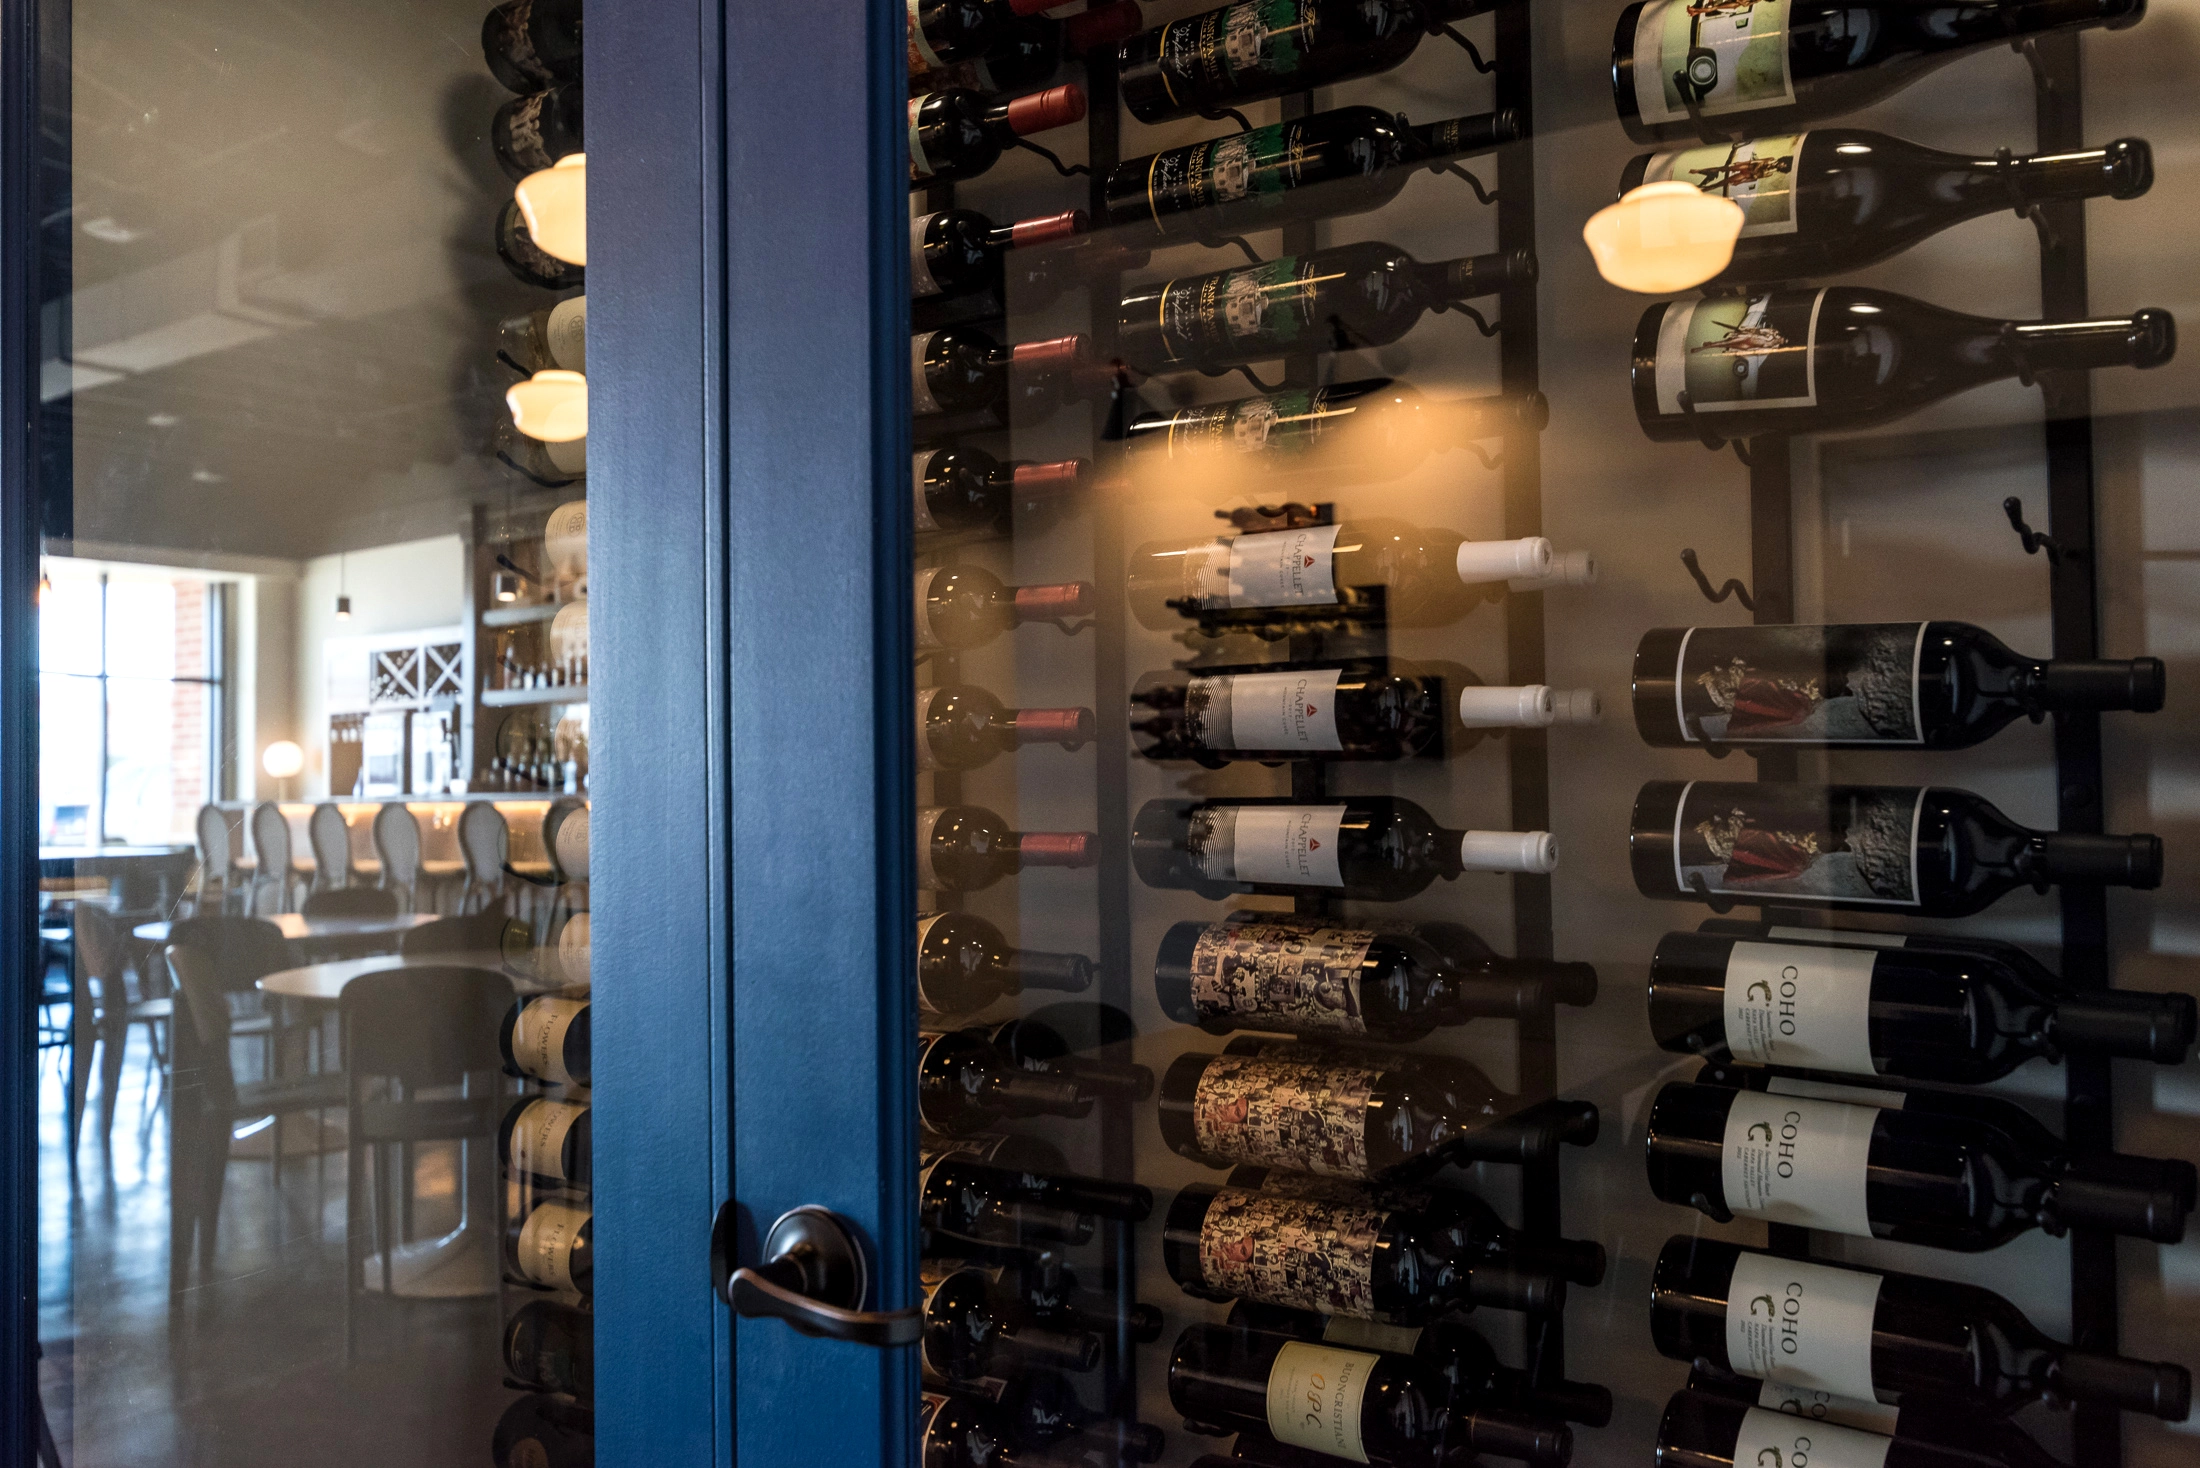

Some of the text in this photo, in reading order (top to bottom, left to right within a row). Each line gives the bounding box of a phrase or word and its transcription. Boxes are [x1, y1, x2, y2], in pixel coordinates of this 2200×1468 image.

[1292, 533, 1308, 595] CHAPPELLET
[1294, 679, 1309, 742] CHAPPELLET
[1297, 813, 1313, 876] CHAPPELLET
[1779, 966, 1799, 1036] COHO
[541, 1014, 559, 1066] FLOWERS
[1777, 1111, 1801, 1178] COHO
[1781, 1282, 1803, 1354] COHO
[1333, 1362, 1355, 1450] BUONCRISTIANI
